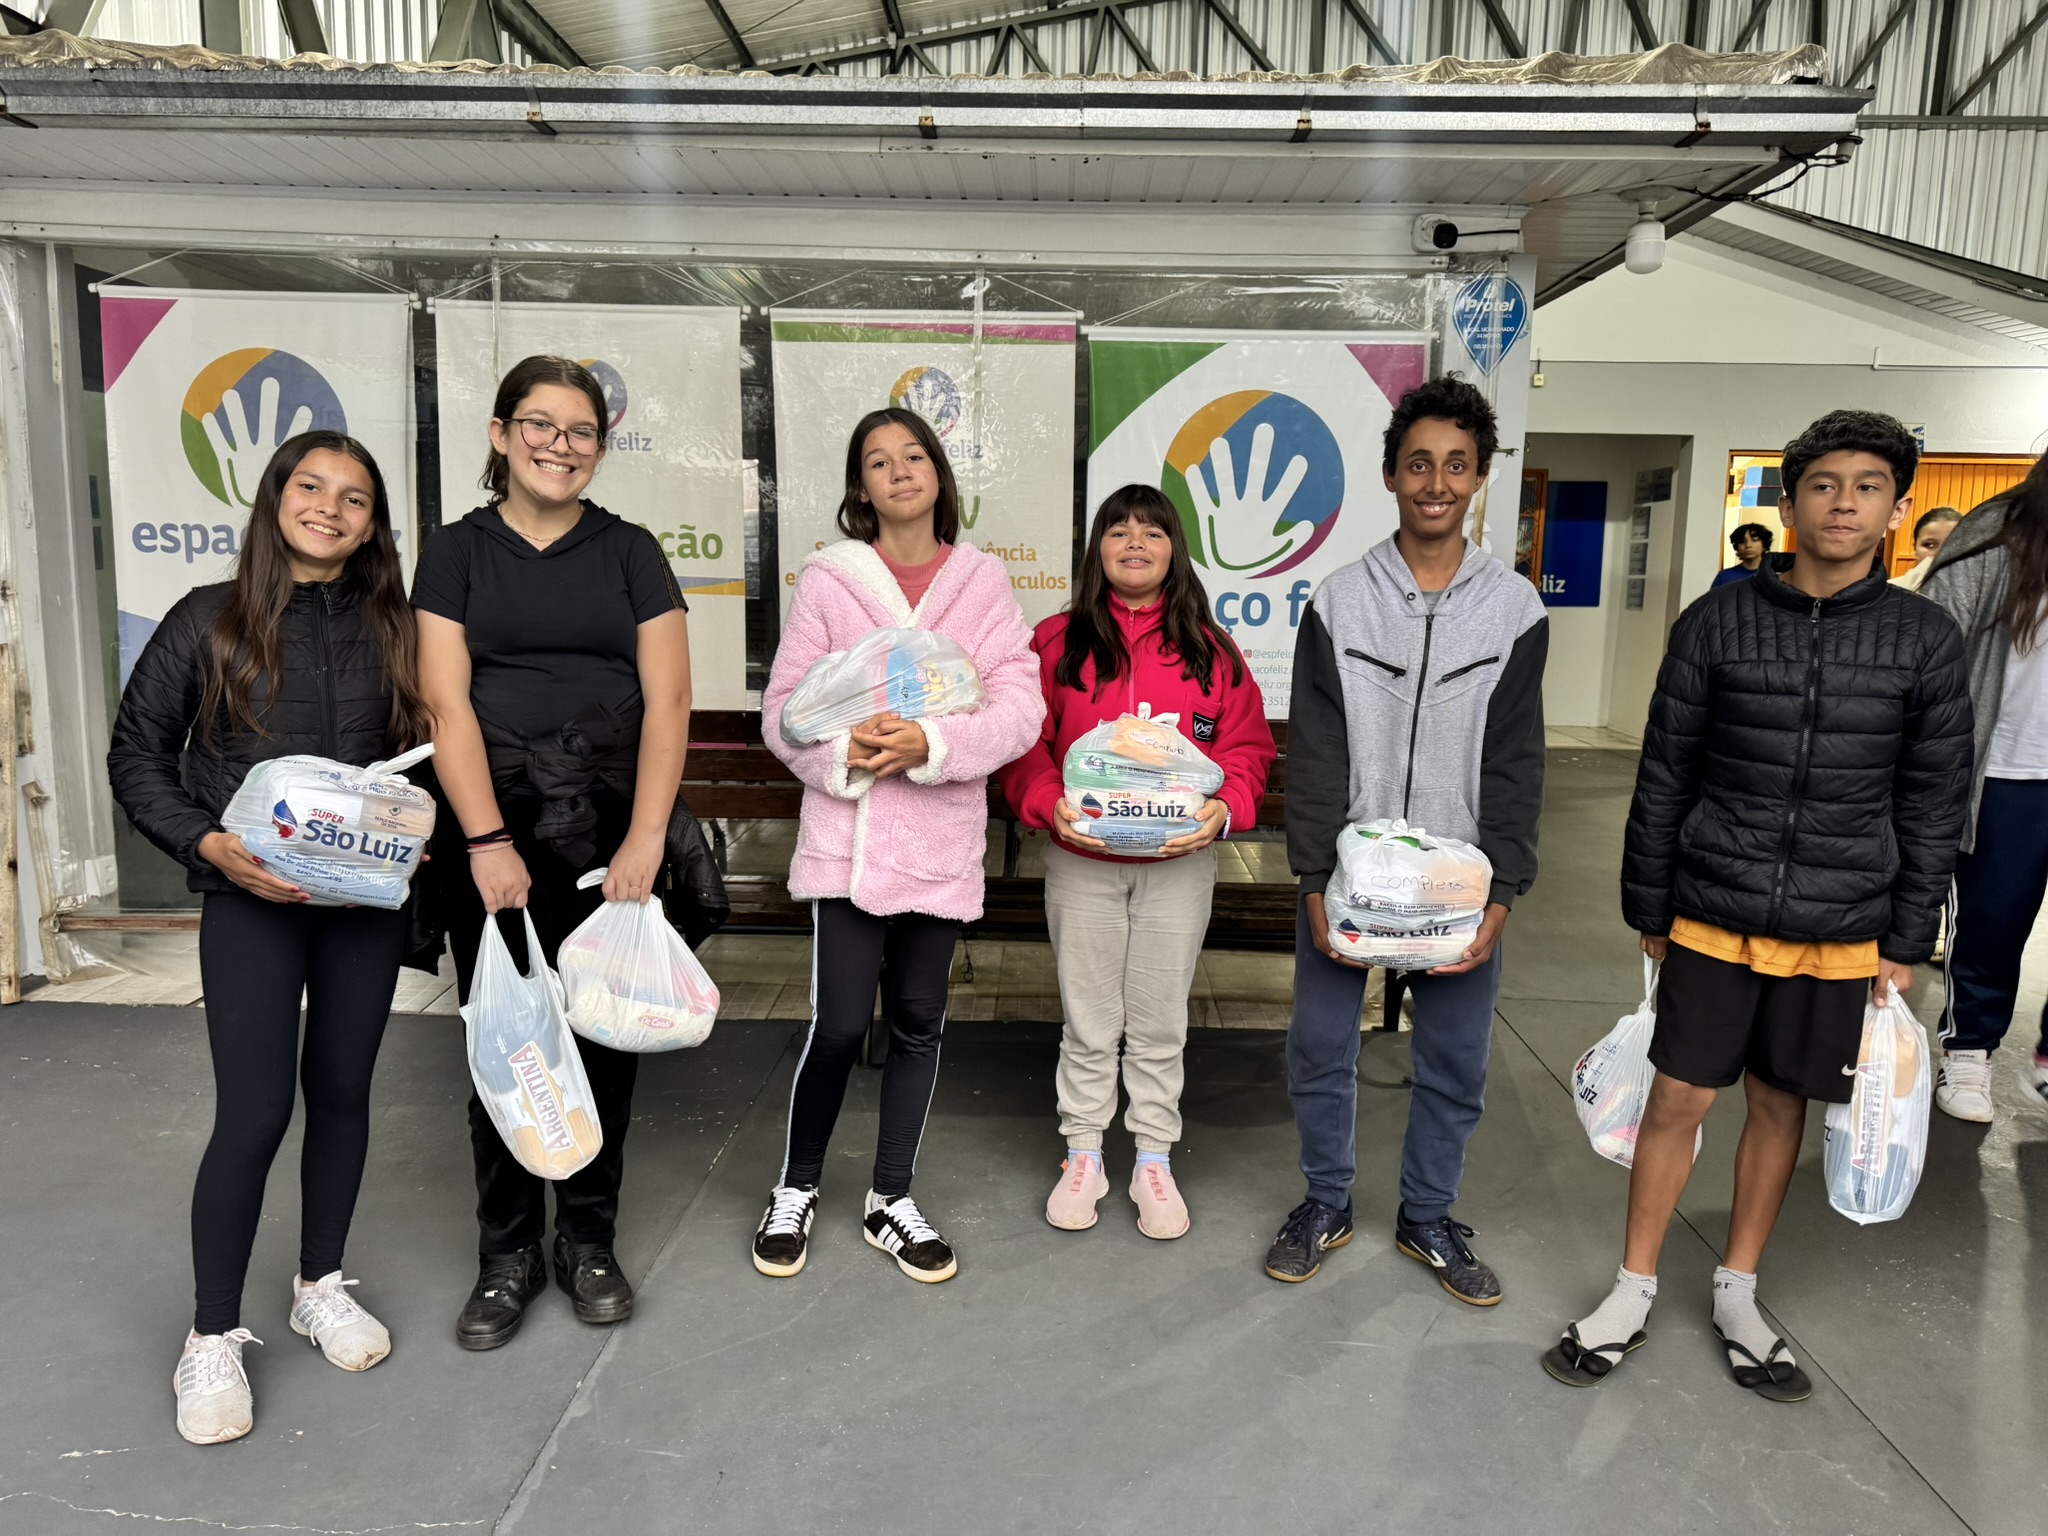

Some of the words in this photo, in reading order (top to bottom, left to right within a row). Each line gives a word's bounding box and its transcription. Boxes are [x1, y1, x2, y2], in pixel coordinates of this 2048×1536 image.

[957, 495, 980, 529] V
[132, 522, 247, 563] espa
[656, 524, 723, 563] ção
[981, 541, 1037, 561] ência
[1009, 571, 1067, 590] nculos
[1539, 574, 1566, 593] liz
[1215, 592, 1271, 635] ço
[1286, 580, 1311, 627] f
[1268, 696, 1290, 706] 3512
[310, 808, 345, 824] SUPER
[1107, 800, 1143, 817] São
[1147, 800, 1187, 817] Luiz
[302, 819, 355, 850] São
[358, 831, 413, 864] Luiz
[509, 1043, 572, 1151] ARGENTINA
